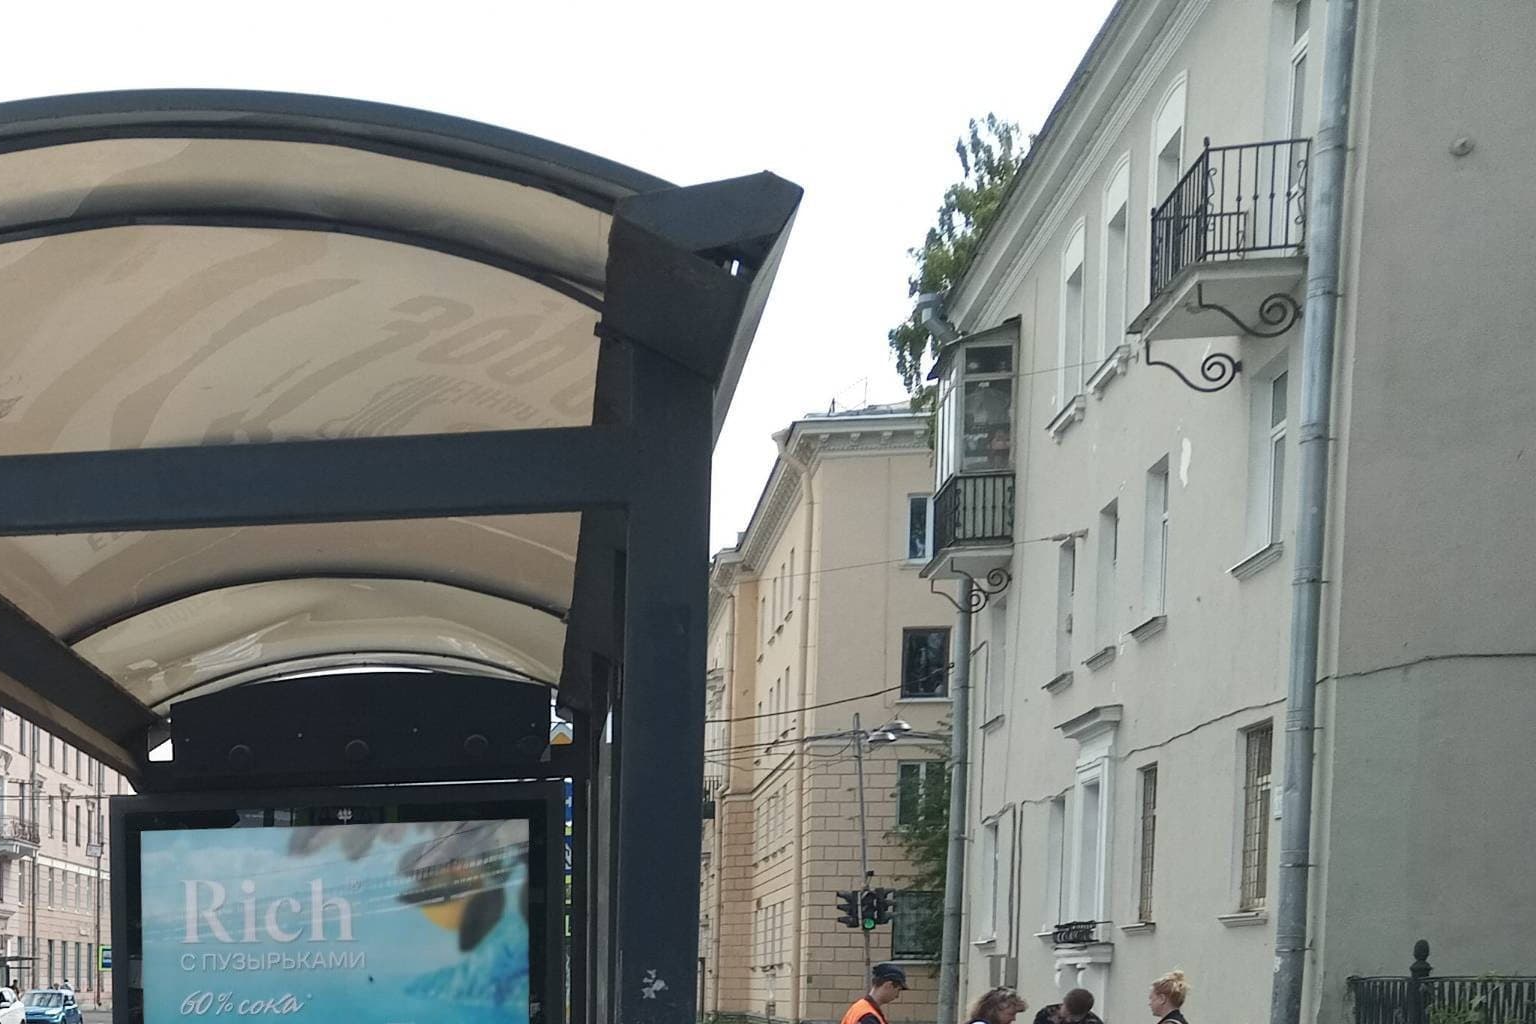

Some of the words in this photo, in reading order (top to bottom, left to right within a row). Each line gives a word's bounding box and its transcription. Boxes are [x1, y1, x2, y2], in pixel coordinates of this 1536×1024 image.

[179, 878, 360, 944] Rich
[180, 953, 196, 971] С
[202, 951, 366, 971] ПУЗЫРЬКАМИ
[180, 990, 234, 1016] 60%
